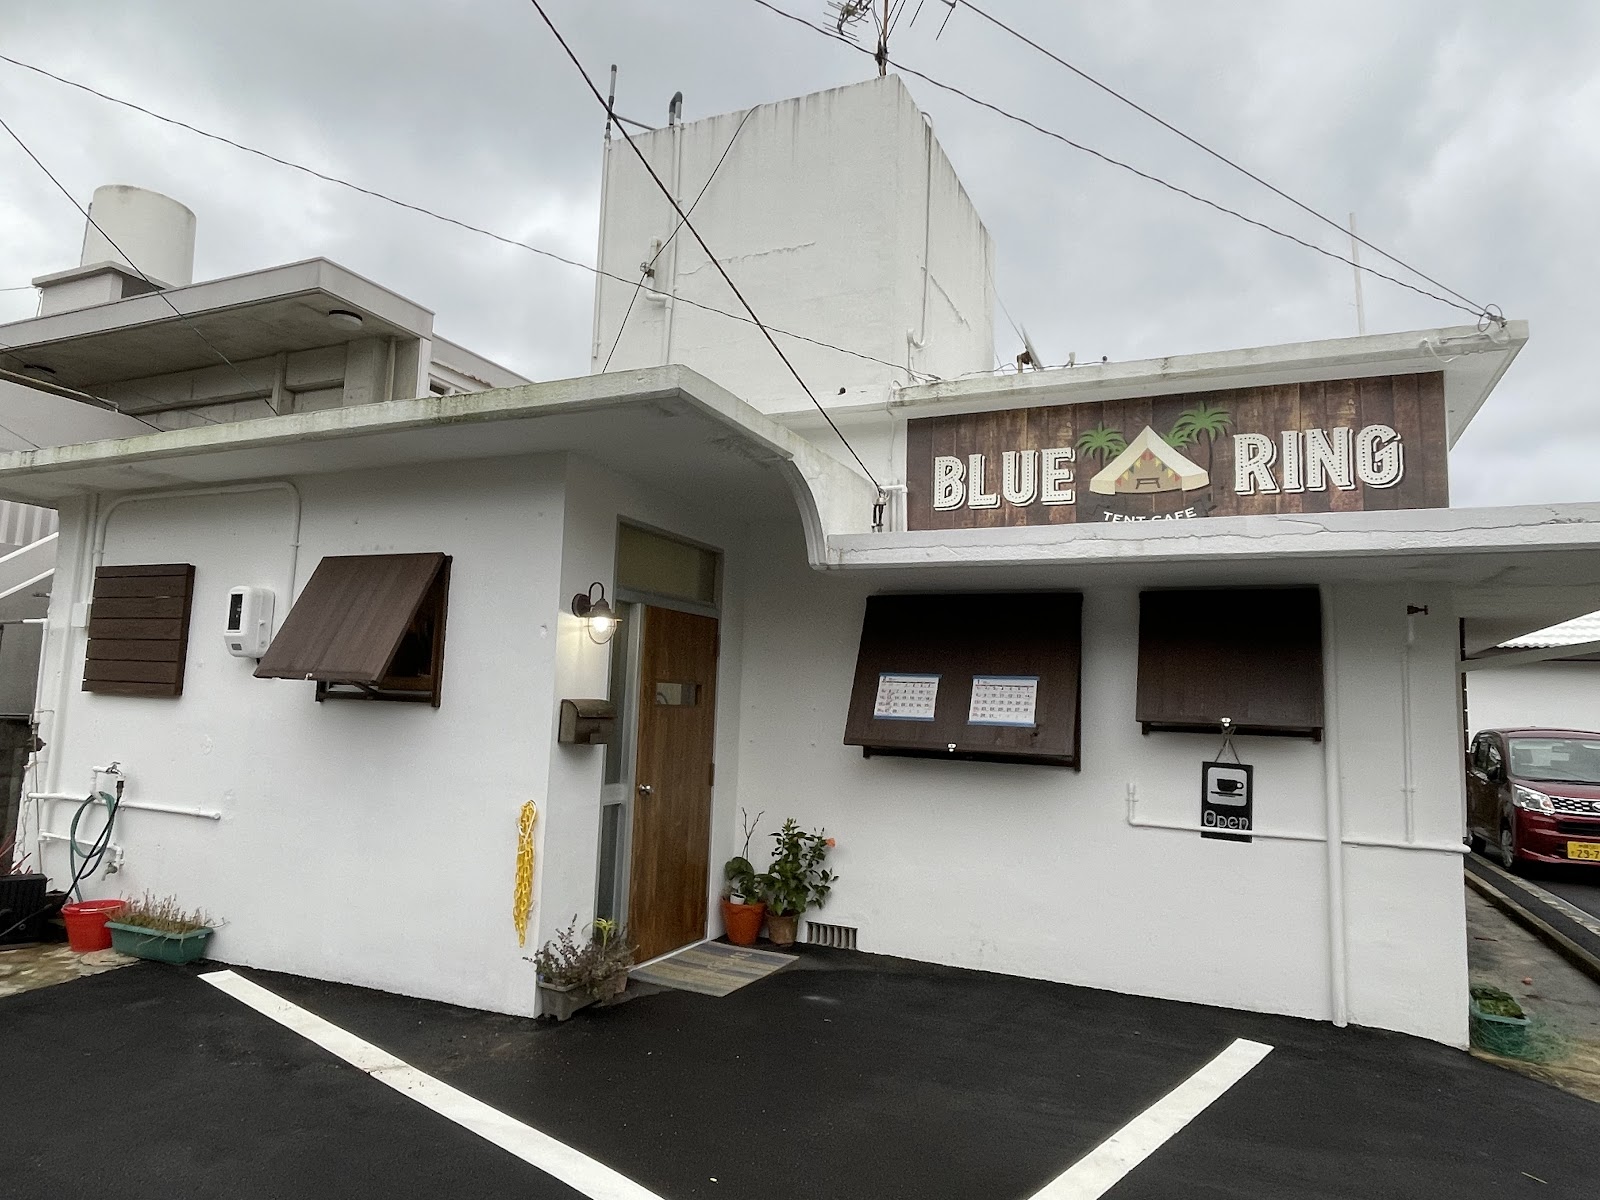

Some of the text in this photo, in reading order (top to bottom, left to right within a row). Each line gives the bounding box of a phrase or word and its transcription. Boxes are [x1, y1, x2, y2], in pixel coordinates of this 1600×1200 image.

[933, 424, 1403, 511] BLUE RING
[1204, 809, 1249, 830] Open
